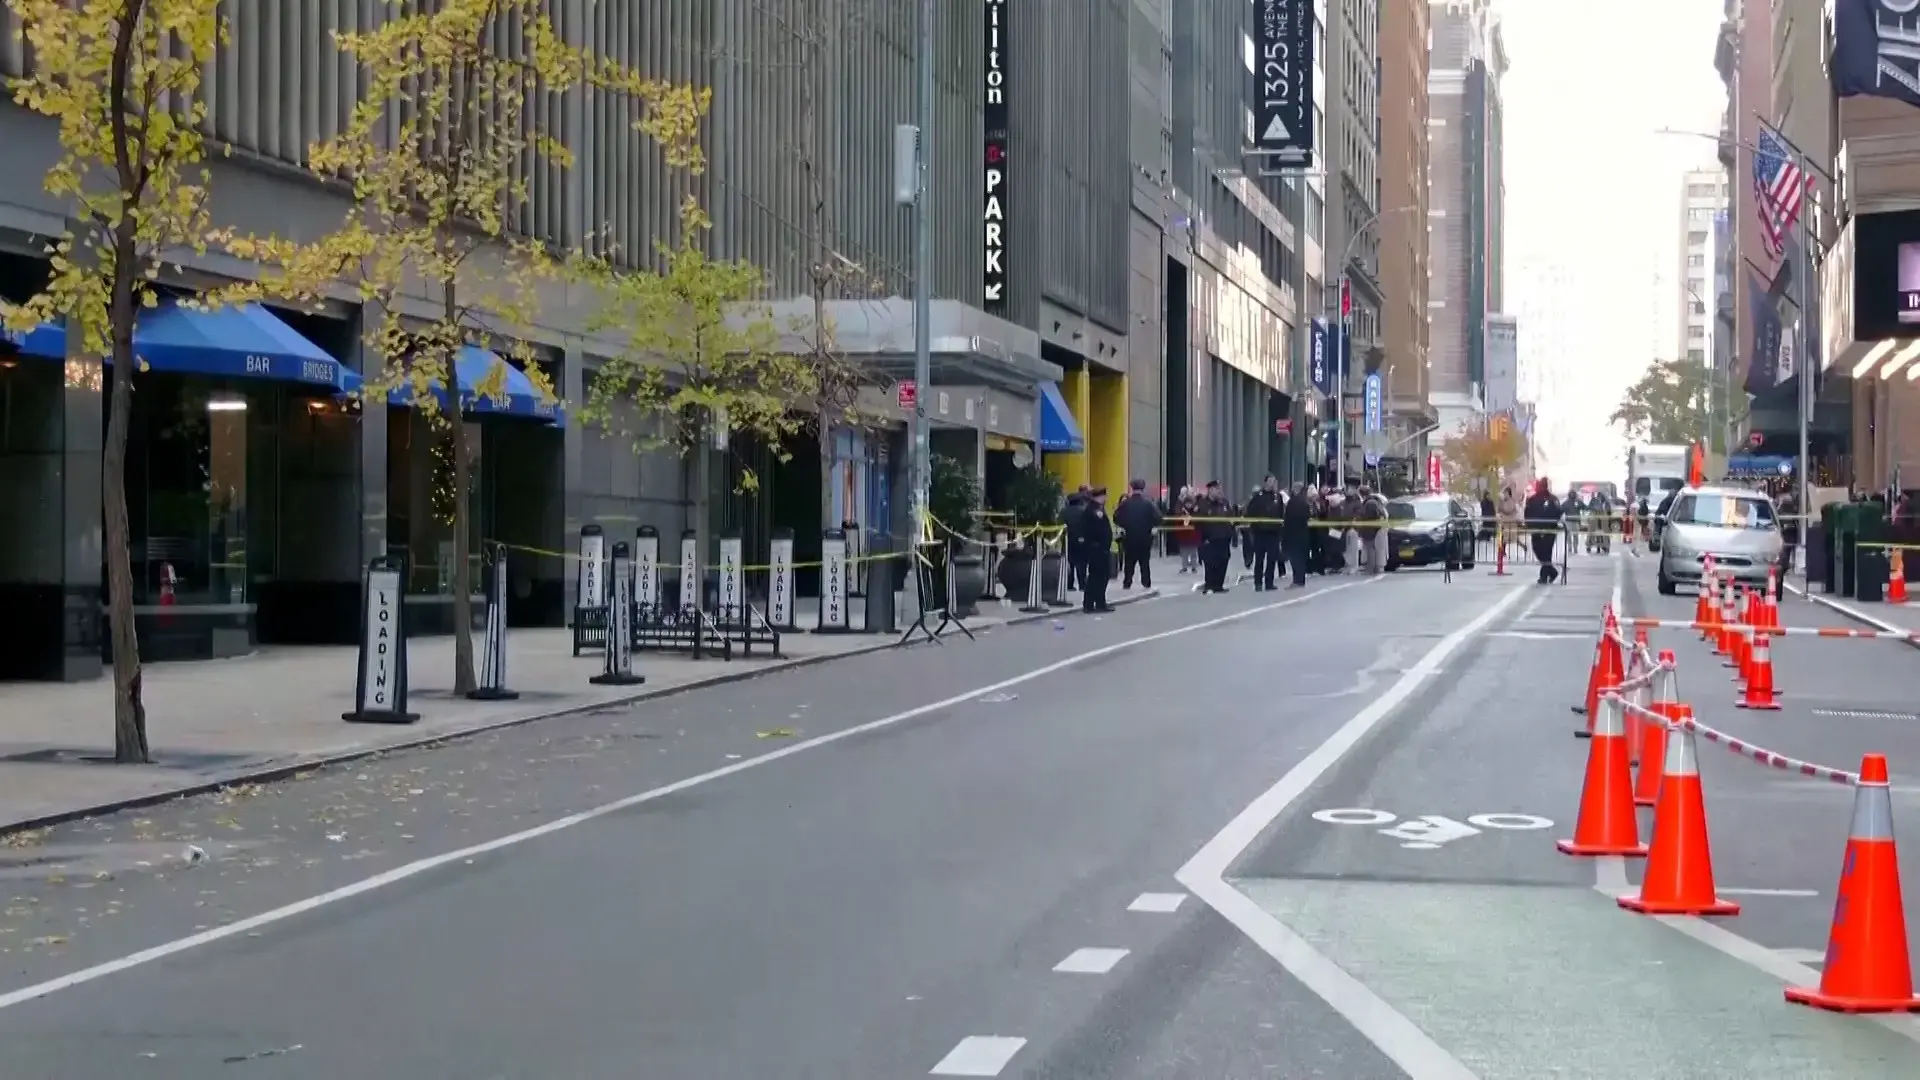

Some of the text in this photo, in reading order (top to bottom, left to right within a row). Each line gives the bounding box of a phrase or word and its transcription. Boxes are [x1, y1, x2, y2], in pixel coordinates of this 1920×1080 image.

[986, 0, 1002, 104] ilton
[1277, 12, 1288, 39] THE
[1876, 0, 1920, 95] ZIE
[1264, 42, 1289, 109] 1325
[985, 168, 1003, 273] PARK
[246, 355, 333, 381] BAR BRIDGES
[587, 551, 595, 607] LOADIN
[726, 555, 734, 618] LOADIN
[775, 555, 784, 621] LOADING
[830, 557, 838, 621] LOADING
[375, 591, 389, 704] LOADING
[620, 580, 629, 668] LOADING
